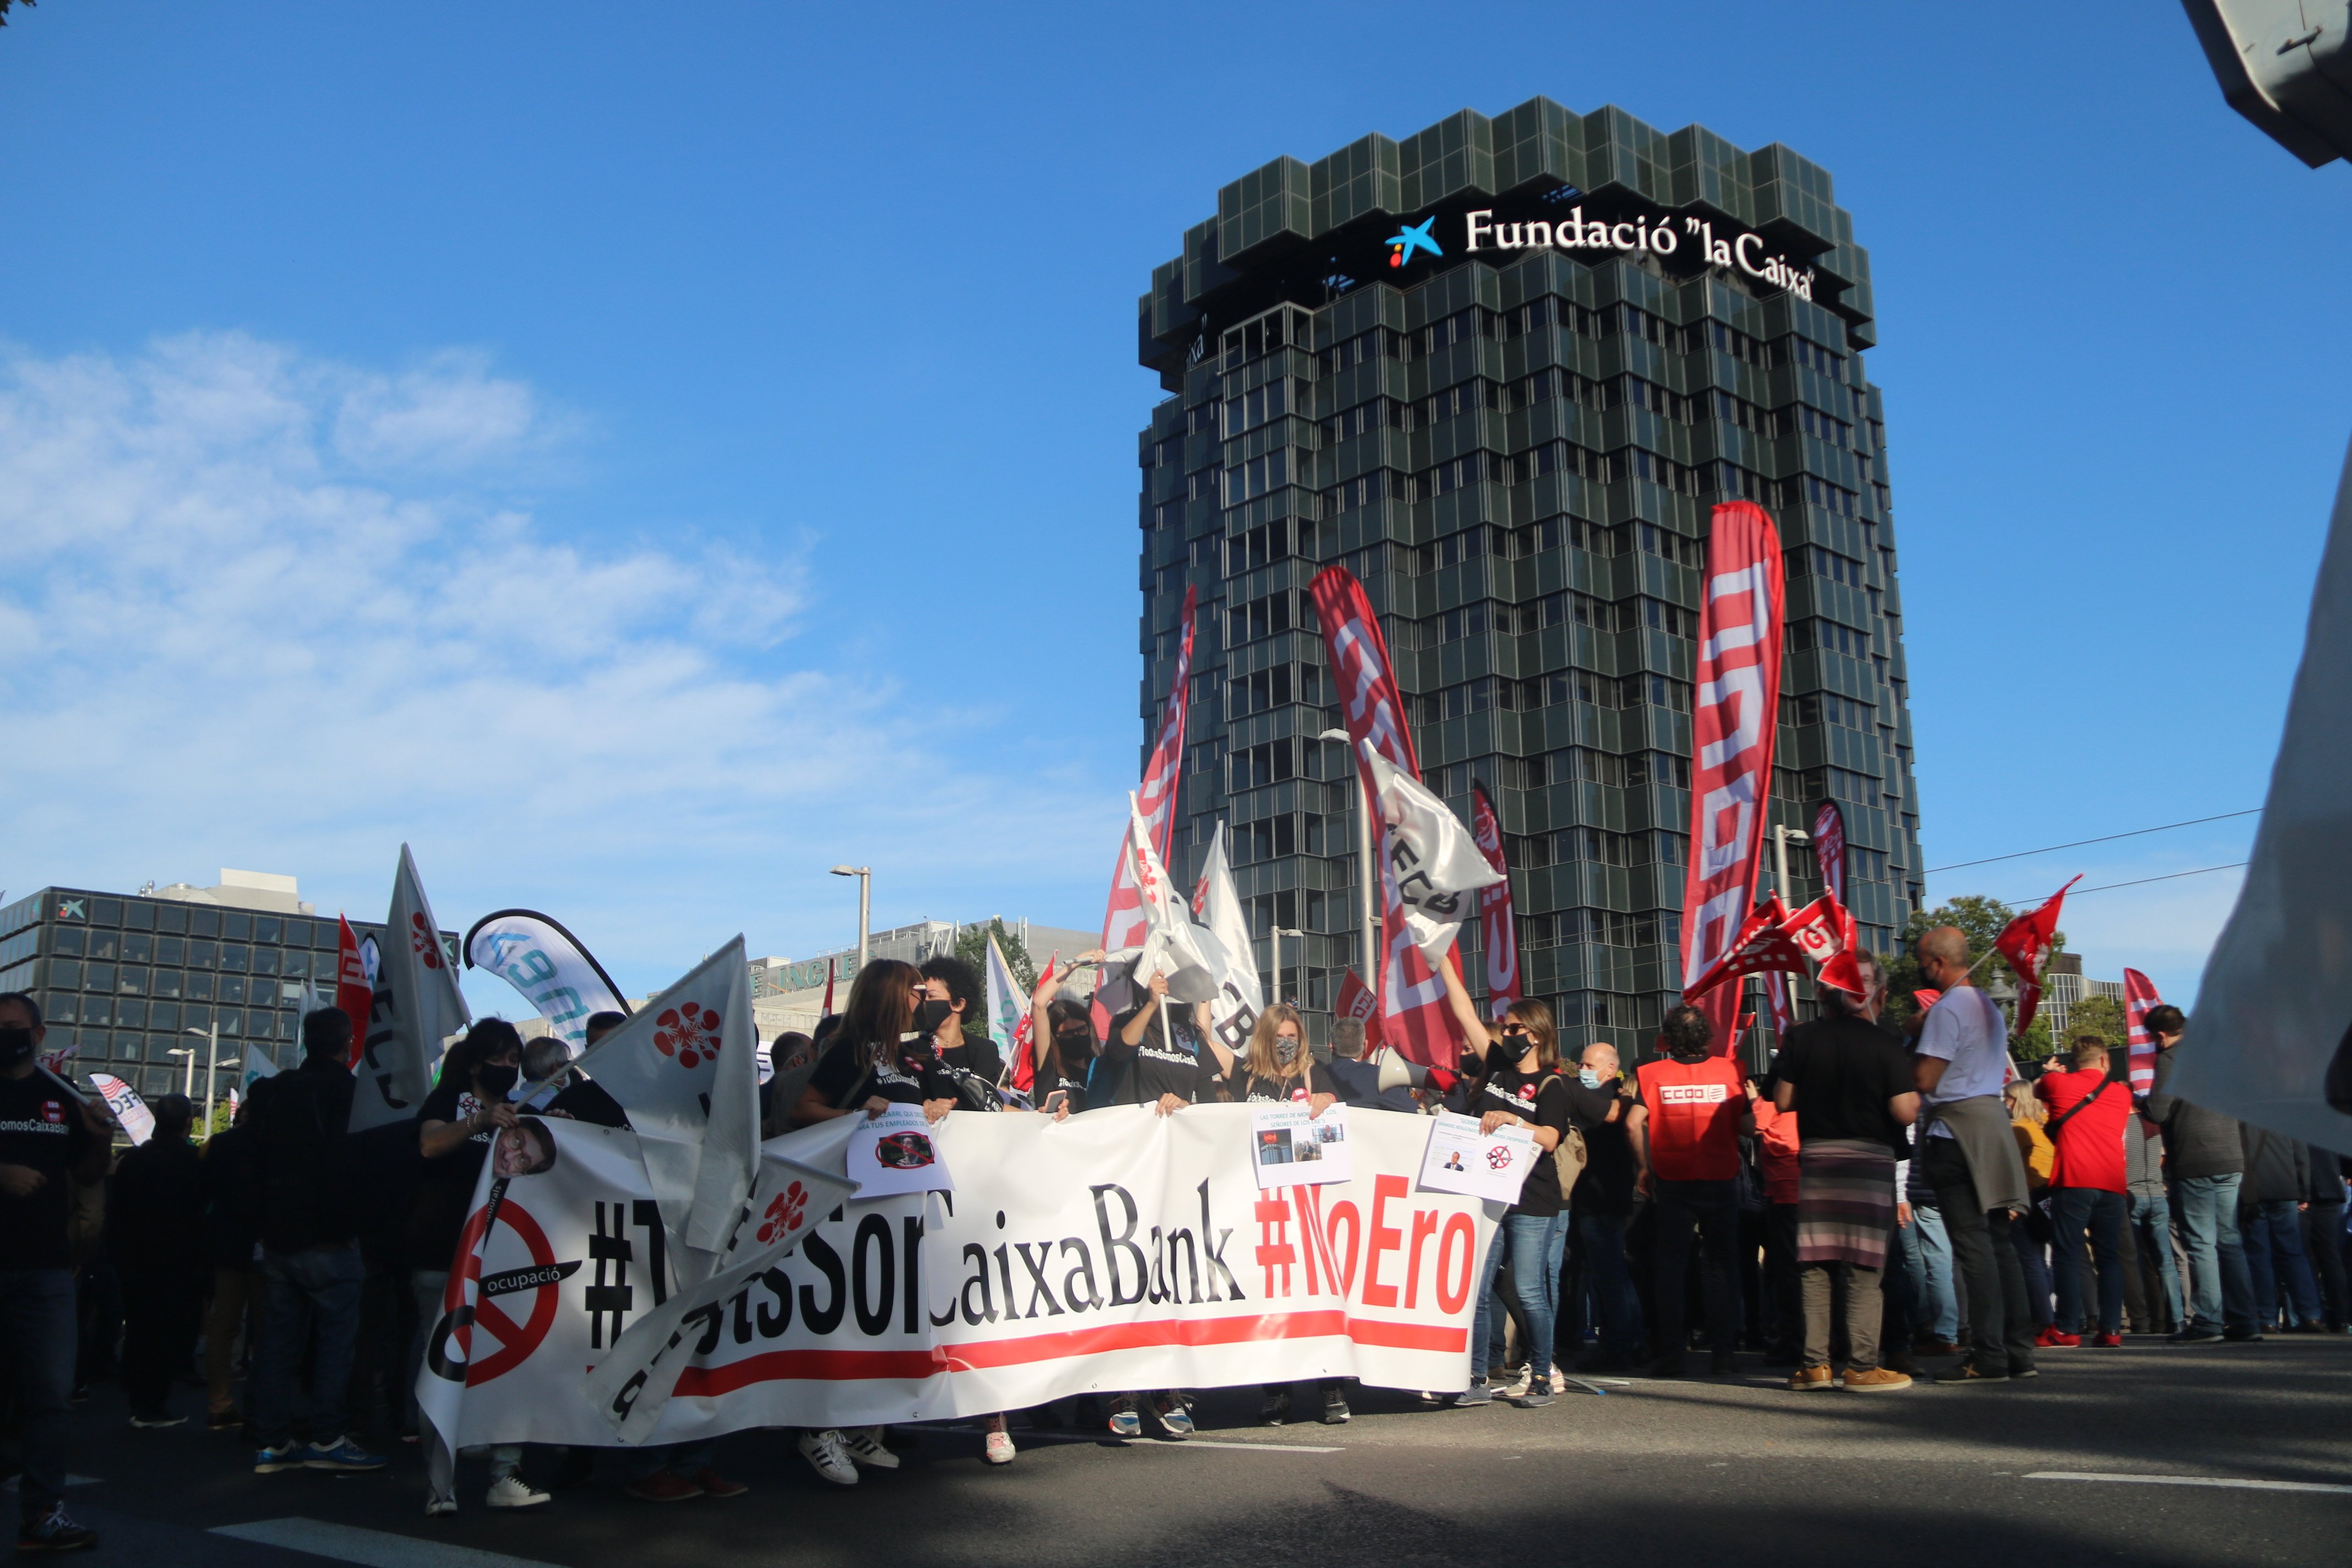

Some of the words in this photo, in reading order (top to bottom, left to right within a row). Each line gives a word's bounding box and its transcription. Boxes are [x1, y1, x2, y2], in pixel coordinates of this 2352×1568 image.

[1465, 205, 1678, 255] Fundació
[1662, 1088, 1705, 1100] CCOO
[885, 1119, 919, 1128] EMPLEADOS
[487, 1266, 560, 1292] ocupació
